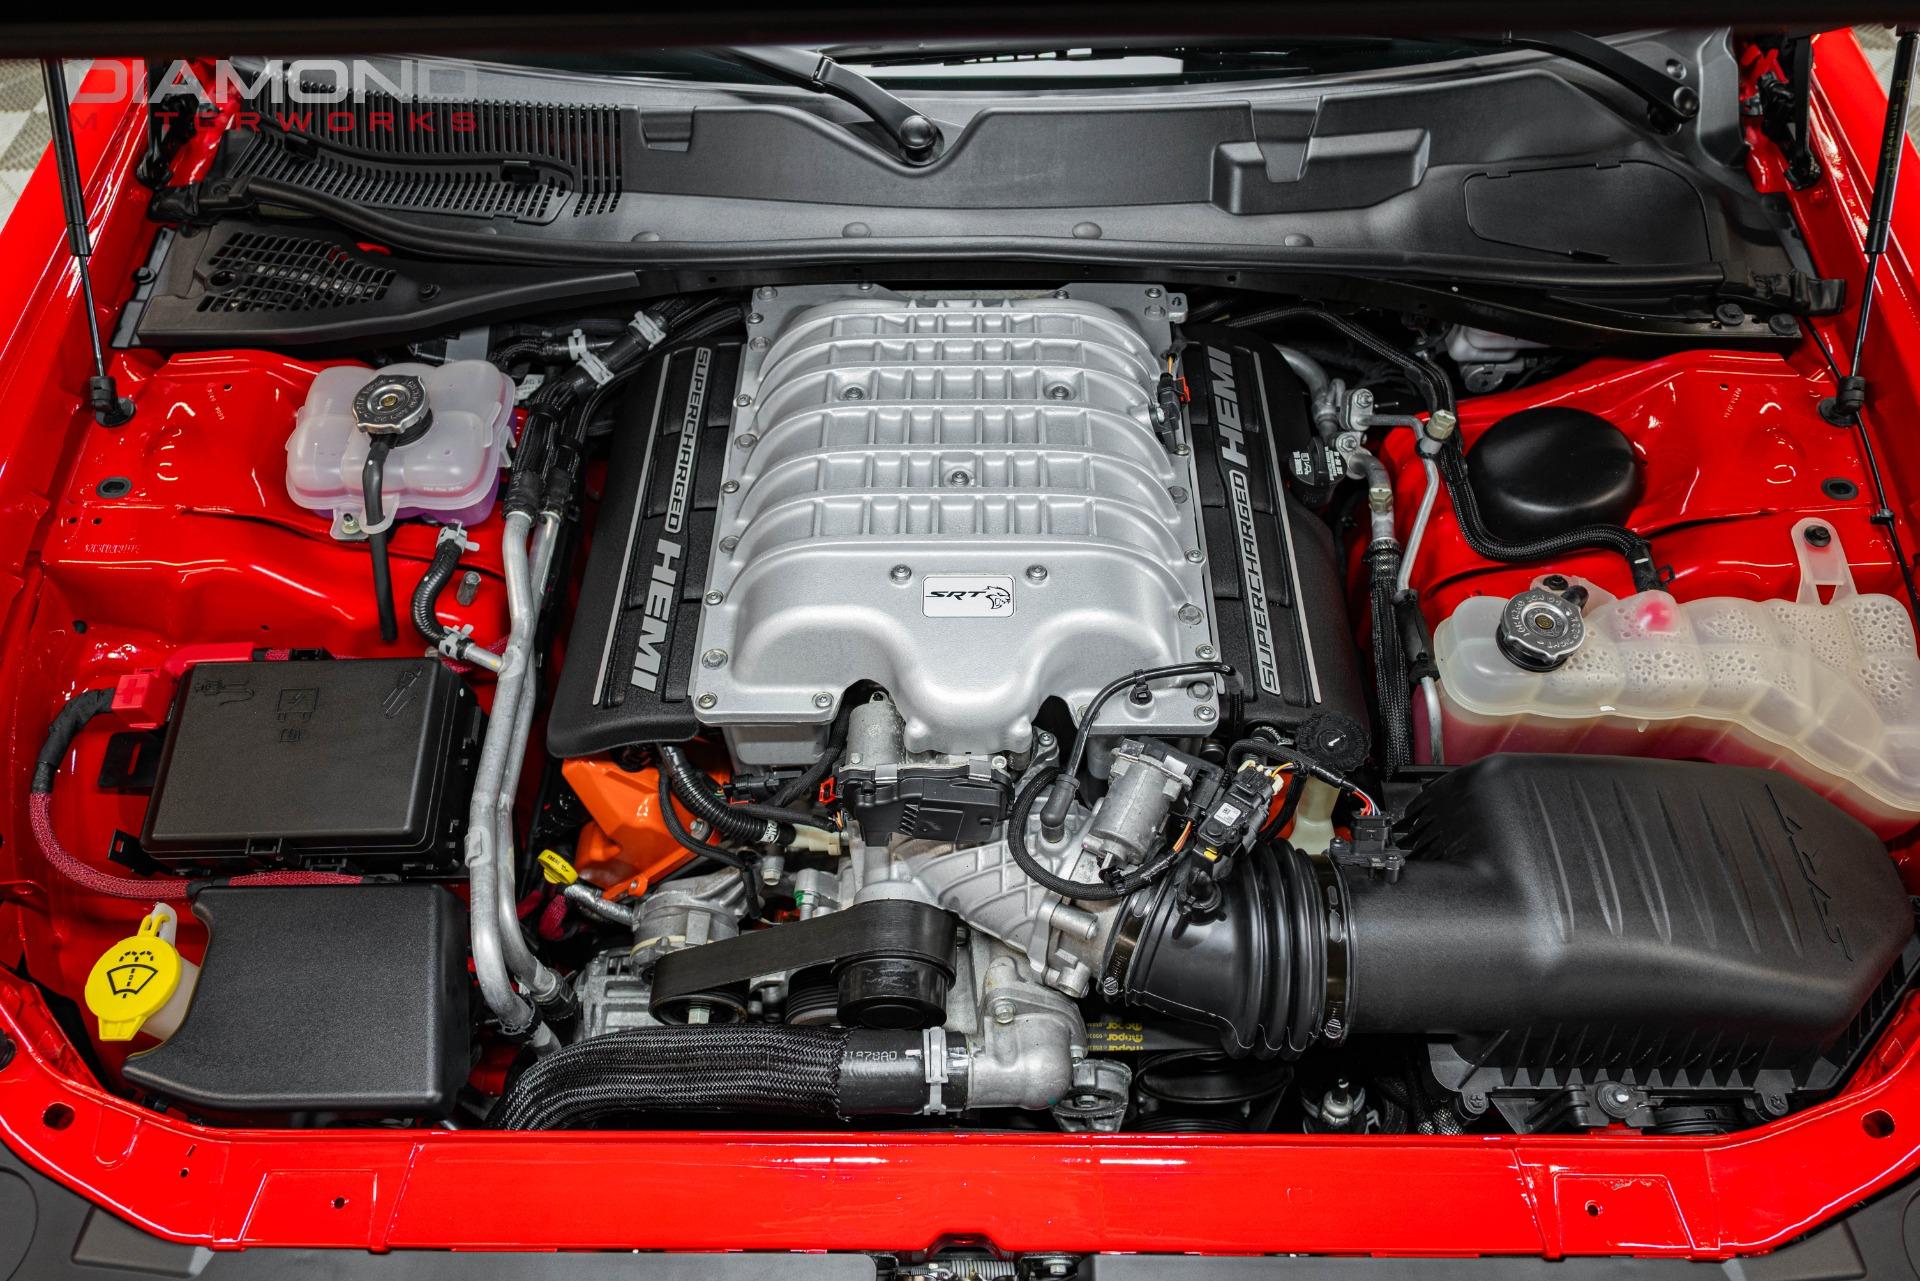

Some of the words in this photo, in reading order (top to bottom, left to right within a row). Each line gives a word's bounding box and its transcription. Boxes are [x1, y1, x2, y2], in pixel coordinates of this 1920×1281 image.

[666, 349, 711, 532] SUPERCHARGED
[1207, 345, 1248, 468] HEMI
[631, 538, 682, 692] HEMI
[925, 591, 987, 600] SRT
[1231, 472, 1280, 694] SUPERCHARGED
